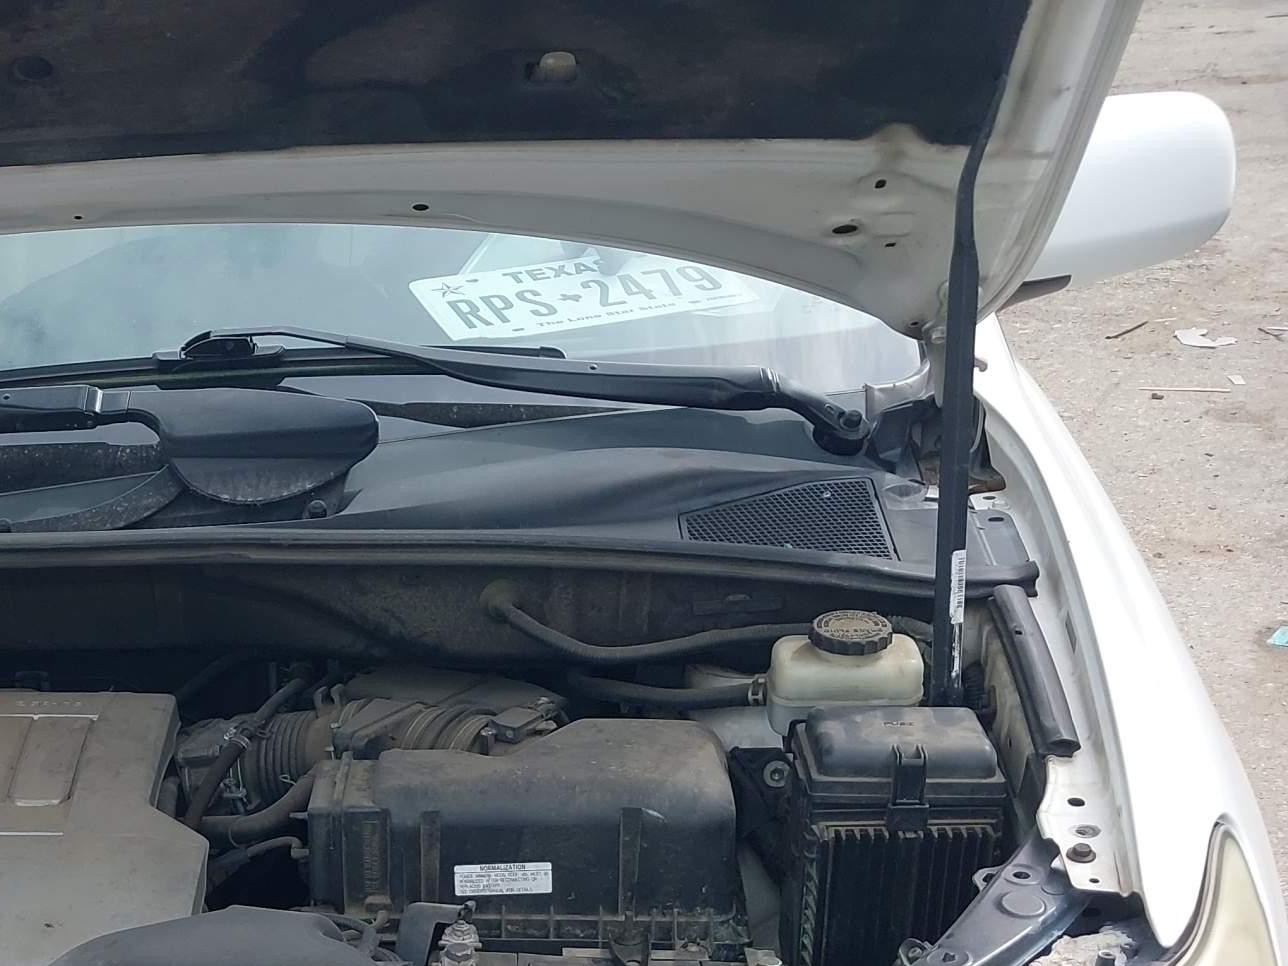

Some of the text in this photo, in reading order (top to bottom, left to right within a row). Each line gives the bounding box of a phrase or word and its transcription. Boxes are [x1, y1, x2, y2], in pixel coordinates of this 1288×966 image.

[446, 265, 722, 329] RPS 2479
[567, 313, 602, 322] Lone
[605, 308, 634, 317] Star
[479, 864, 526, 872] NORMALIZATION
